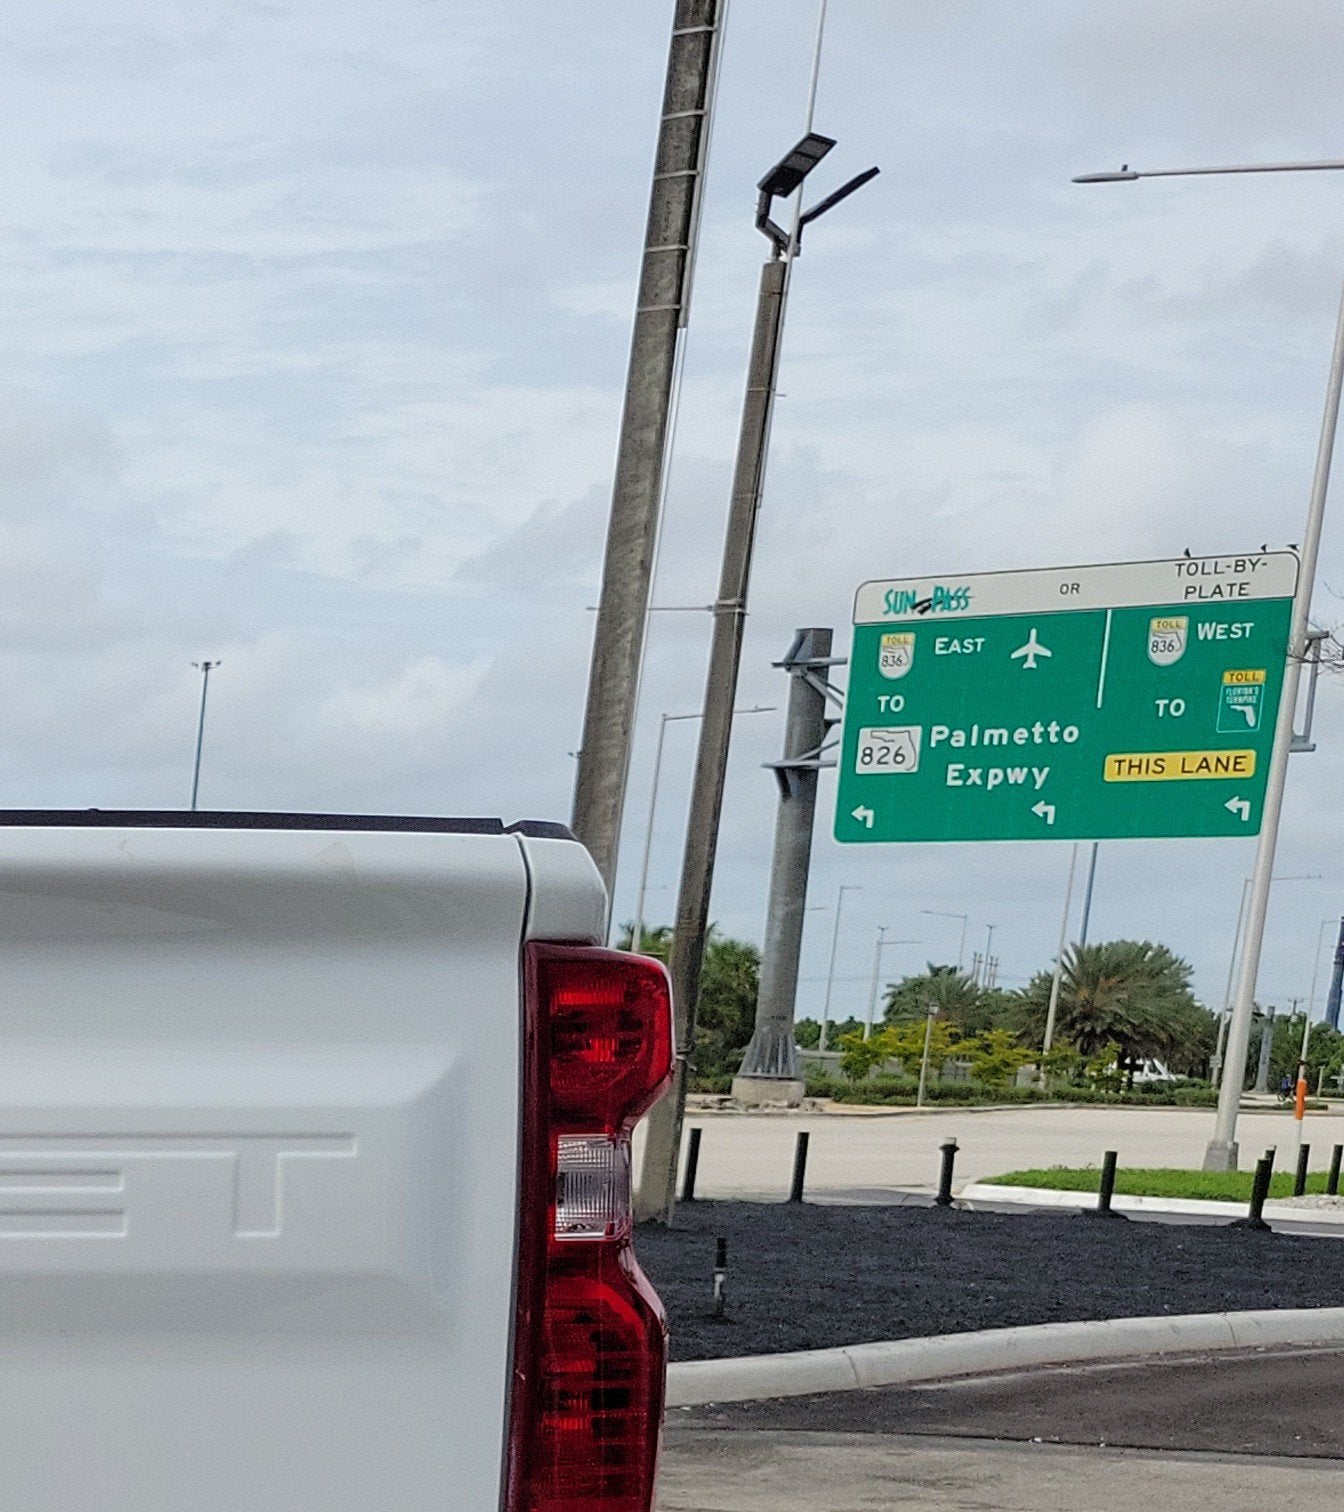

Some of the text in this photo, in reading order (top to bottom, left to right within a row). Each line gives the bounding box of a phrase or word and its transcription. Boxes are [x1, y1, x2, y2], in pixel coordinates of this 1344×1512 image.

[1059, 583, 1081, 595] OR
[1184, 582, 1250, 600] PLATE
[1155, 619, 1182, 630] TOLL
[1197, 620, 1255, 642] WEST
[934, 636, 986, 656] EAST
[1150, 639, 1176, 654] 836
[881, 655, 904, 668] 836
[1228, 671, 1260, 683] TOLL
[877, 695, 905, 713] TO
[1155, 699, 1186, 717] TO
[929, 720, 1080, 748] Palmetto
[860, 745, 907, 766] 826
[1113, 755, 1248, 776] THIS LANE
[946, 763, 1050, 791] Expwy
